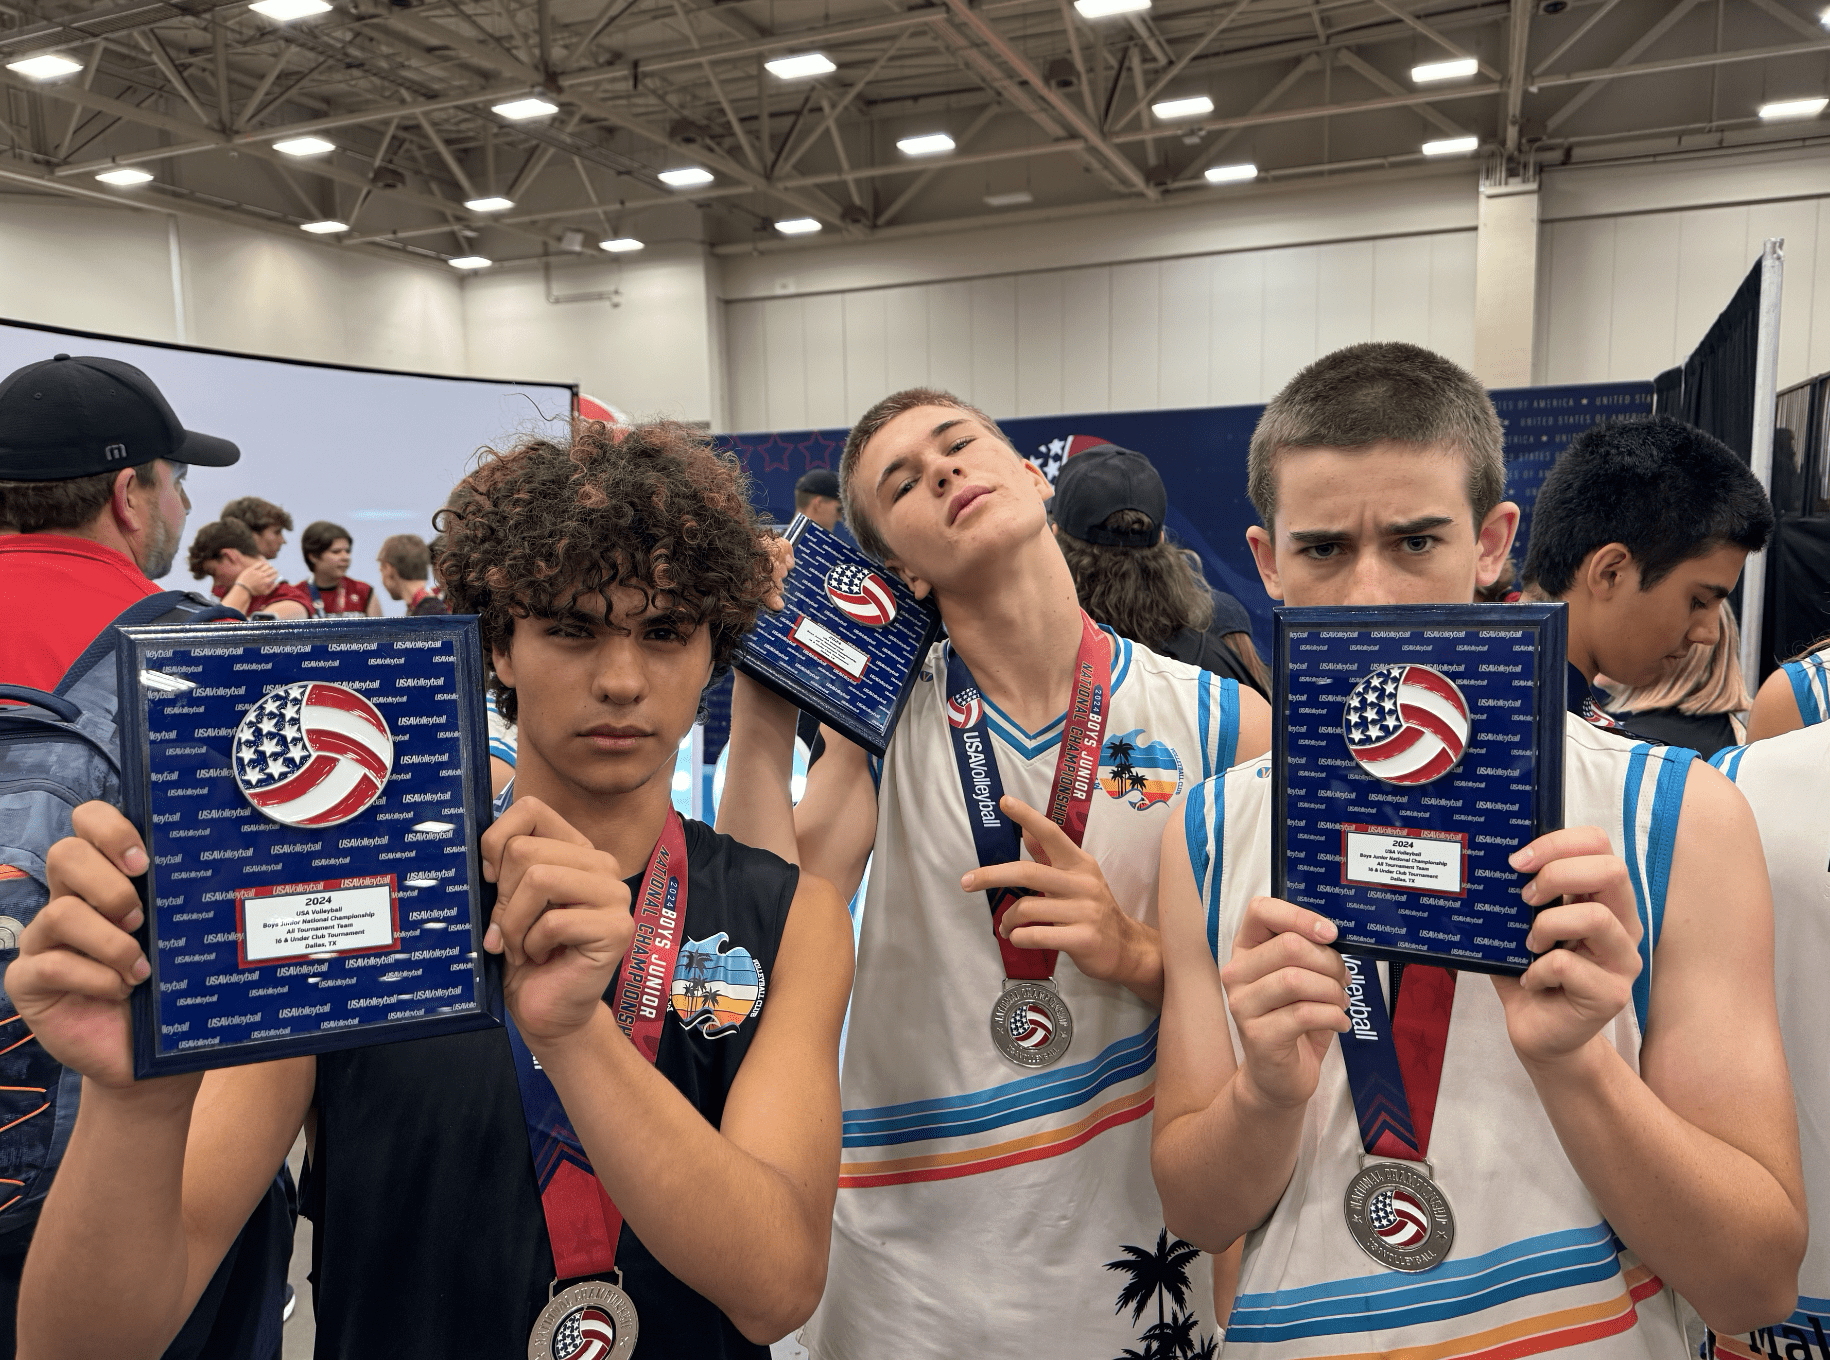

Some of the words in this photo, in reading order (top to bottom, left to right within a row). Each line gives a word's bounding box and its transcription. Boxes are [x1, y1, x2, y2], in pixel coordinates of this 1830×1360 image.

[1532, 398, 1574, 408] AMERICA
[1595, 394, 1631, 406] UNITED
[1635, 393, 1652, 404] STA
[1320, 631, 1360, 640] USAVolleyball
[1370, 631, 1411, 640] USAVolleyball
[1423, 631, 1466, 640] USAVolleyball
[1478, 630, 1523, 640] USAVolleyball
[190, 646, 244, 658] USAVolleyball
[260, 643, 312, 655] USAVolleyball
[328, 641, 378, 652] USAVolleyball
[393, 638, 442, 650] USAVolleyball
[161, 664, 203, 674] USAVolleyball
[233, 662, 273, 671] USAVolleyball
[301, 659, 340, 668] USAVolleyball
[368, 656, 406, 666] USAVolleyball
[1319, 663, 1359, 672] USAVolleyball
[1478, 664, 1522, 674] USAVolleyball
[192, 686, 246, 698] USAVolleyball
[395, 676, 444, 688] USAVolleyball
[1072, 660, 1094, 722] NATIONAL
[163, 705, 205, 715] USAVolleyball
[370, 695, 408, 704] USAVolleyball
[1092, 688, 1102, 712] 2024
[1477, 698, 1522, 709] USAVolleyball
[398, 714, 446, 726] USAVolleyball
[1084, 712, 1102, 748] BOYS
[1477, 732, 1521, 743] USAVolleyball
[165, 745, 207, 756] USAVolleyball
[400, 752, 449, 765] USAVolleyball
[963, 731, 1002, 828] USAVolleyball
[1052, 725, 1084, 827] CHAMPIONSHIP
[1072, 750, 1094, 800] JUNIOR
[1476, 766, 1520, 777] USAVolleyball
[167, 786, 209, 798] USAVolleyball
[1318, 789, 1357, 800] USAVolleyball
[1368, 793, 1409, 804] USAVolleyball
[1420, 797, 1463, 808] USAVolleyball
[1476, 800, 1520, 812] USAVolleyball
[198, 806, 252, 820] USAVolleyball
[402, 790, 451, 804] USAVolleyball
[169, 827, 211, 839] USAVolleyball
[376, 810, 414, 821] USAVolleyball
[1317, 821, 1356, 832] USAVolleyball
[1475, 834, 1519, 846] USAVolleyball
[200, 847, 254, 861] USAVolleyball
[270, 841, 323, 855] USAVolleyball
[338, 835, 389, 849] USAVolleyball
[404, 829, 453, 843] USAVolleyball
[170, 868, 213, 881] USAVolleyball
[242, 862, 283, 874] USAVolleyball
[312, 856, 351, 867] USAVolleyball
[378, 849, 417, 861] USAVolleyball
[1475, 868, 1519, 880] USAVolleyball
[201, 888, 256, 903] USAVolleyball
[272, 881, 325, 896] USAVolleyball
[340, 874, 391, 889] USAVolleyball
[406, 868, 456, 882] USAVolleyball
[642, 844, 670, 917] NATIONAL
[305, 896, 332, 906] 2024
[666, 882, 678, 908] 2024
[1316, 884, 1355, 896] USAVolleyball
[1366, 890, 1407, 902] USAVolleyball
[1419, 896, 1461, 908] USAVolleyball
[1474, 902, 1518, 915] USAVolleyball
[172, 910, 214, 922] USAVolleyball
[302, 916, 329, 924] National
[330, 912, 375, 922] Championship
[311, 906, 342, 916] Volleyball
[409, 907, 458, 922] USAVolleyball
[297, 924, 335, 933] Tournament
[327, 929, 365, 938] Tournament
[655, 906, 677, 949] BOYS
[1366, 922, 1407, 935] USAVolleyball
[1418, 929, 1461, 942] USAVolleyball
[1474, 936, 1518, 949] USAVolleyball
[174, 952, 216, 964] USAVolleyball
[205, 970, 260, 986] USAVolleyball
[276, 962, 329, 977] USAVolleyball
[345, 954, 396, 969] USAVolleyball
[411, 946, 460, 961] USAVolleyball
[176, 993, 218, 1007] USAVolleyball
[248, 984, 289, 997] USAVolleyball
[318, 976, 358, 988] USAVolleyball
[639, 953, 667, 1018] JUNIOR
[207, 1012, 262, 1028] USAVolleyball
[278, 1002, 331, 1019] USAVolleyball
[347, 994, 398, 1010] USAVolleyball
[413, 985, 463, 1001] USAVolleyball
[750, 1000, 762, 1018] CLUB
[178, 1035, 220, 1049] USAVolleyball
[250, 1026, 292, 1039] USAVolleyball
[320, 1016, 360, 1029] USAVolleyball
[387, 1007, 426, 1020] USAVolleyball
